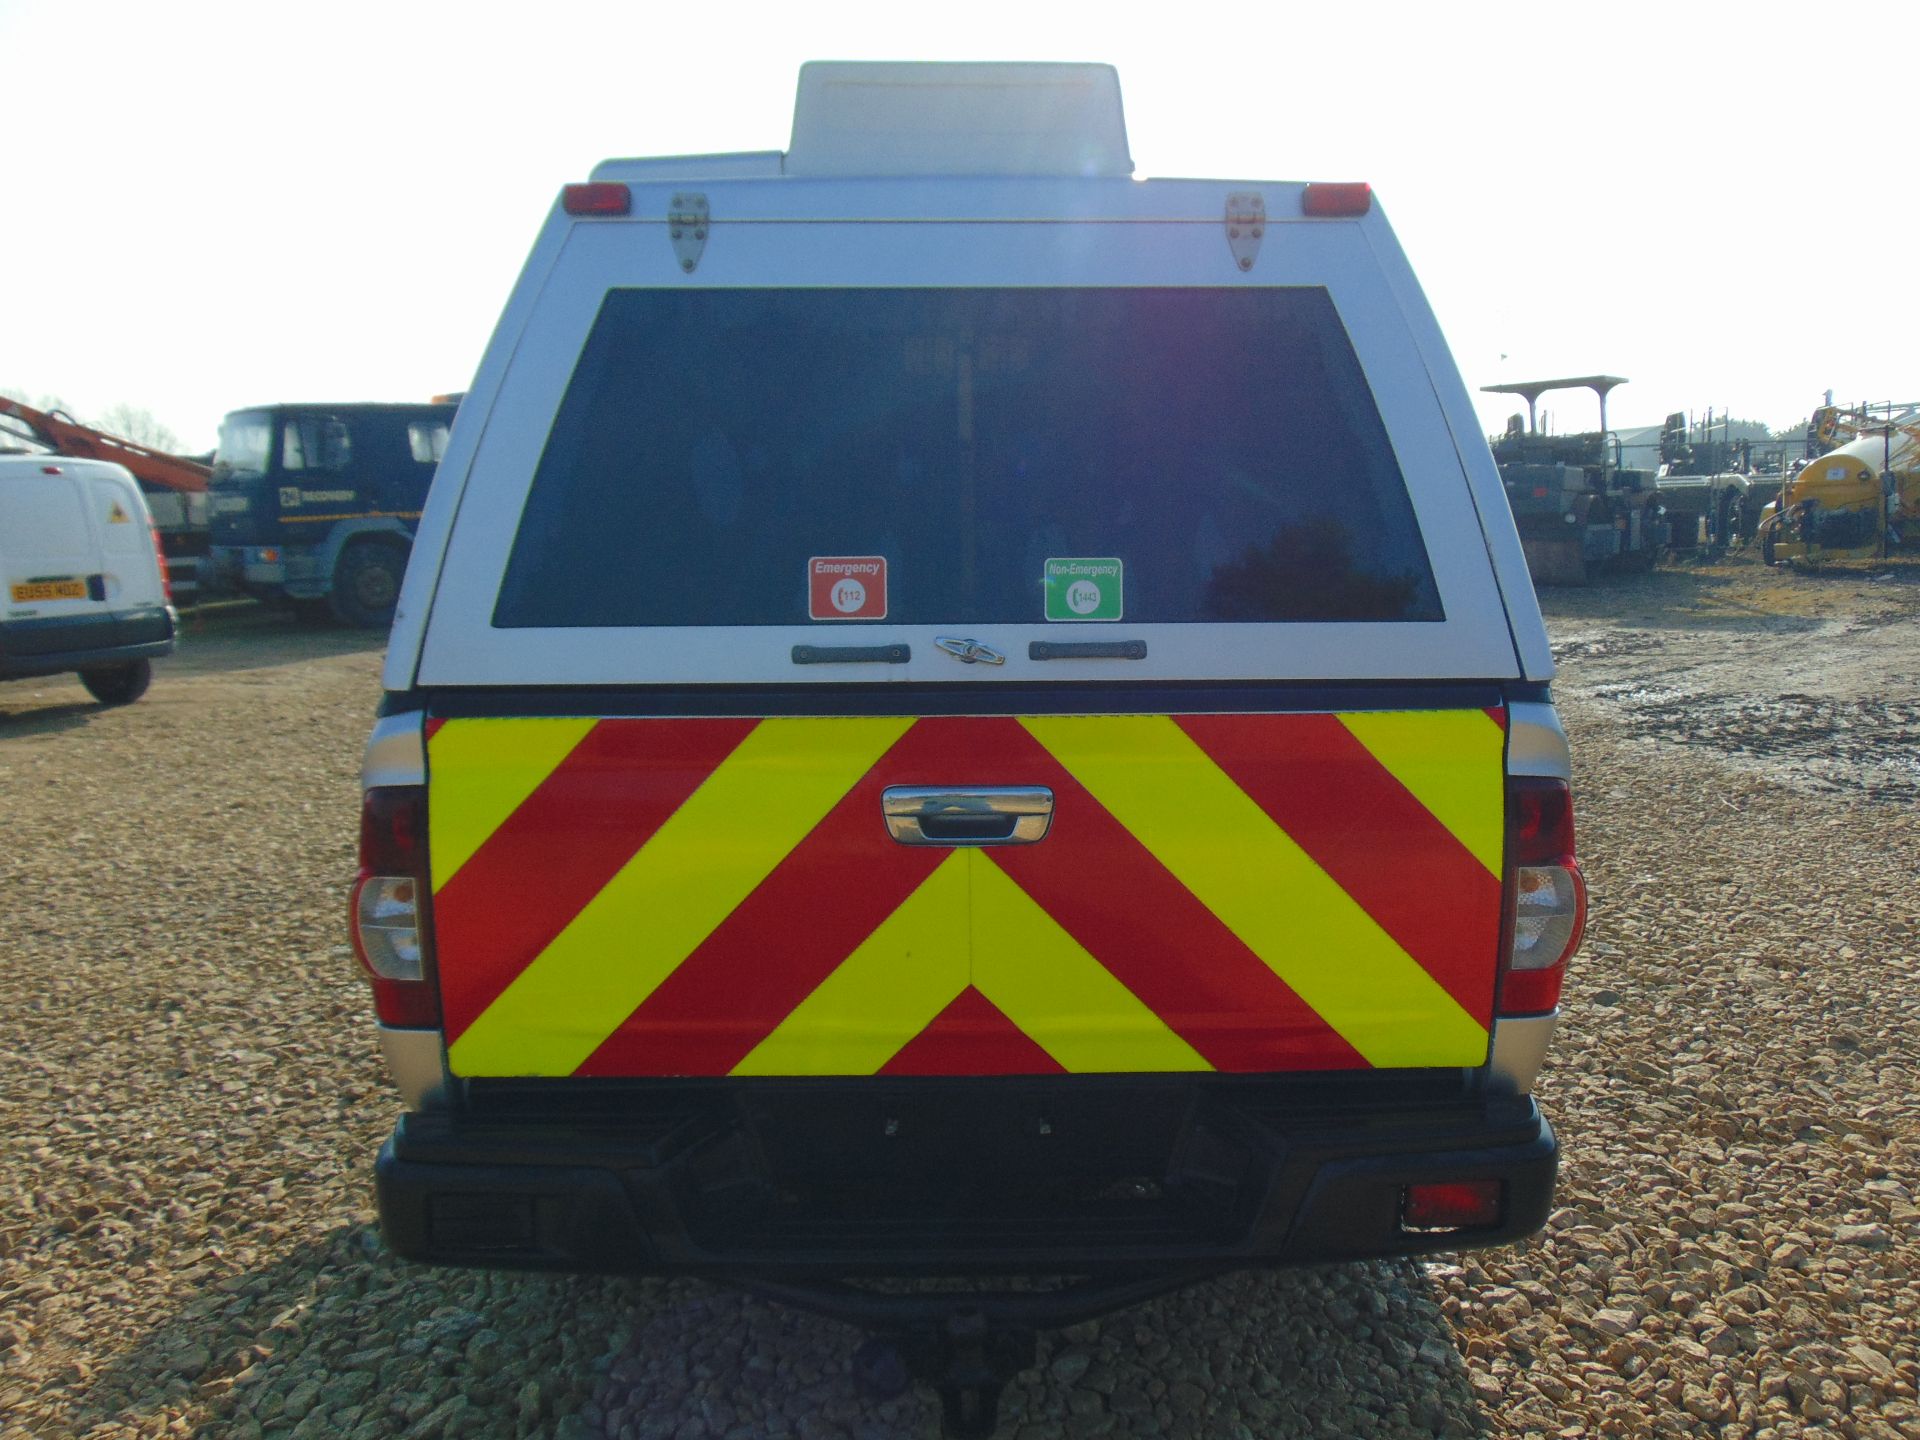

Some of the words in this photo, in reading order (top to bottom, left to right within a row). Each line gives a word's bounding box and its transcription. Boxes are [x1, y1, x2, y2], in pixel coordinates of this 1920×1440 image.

[815, 561, 880, 576] Emergency
[1049, 563, 1118, 577] Non-Emergency
[844, 590, 861, 601] 112
